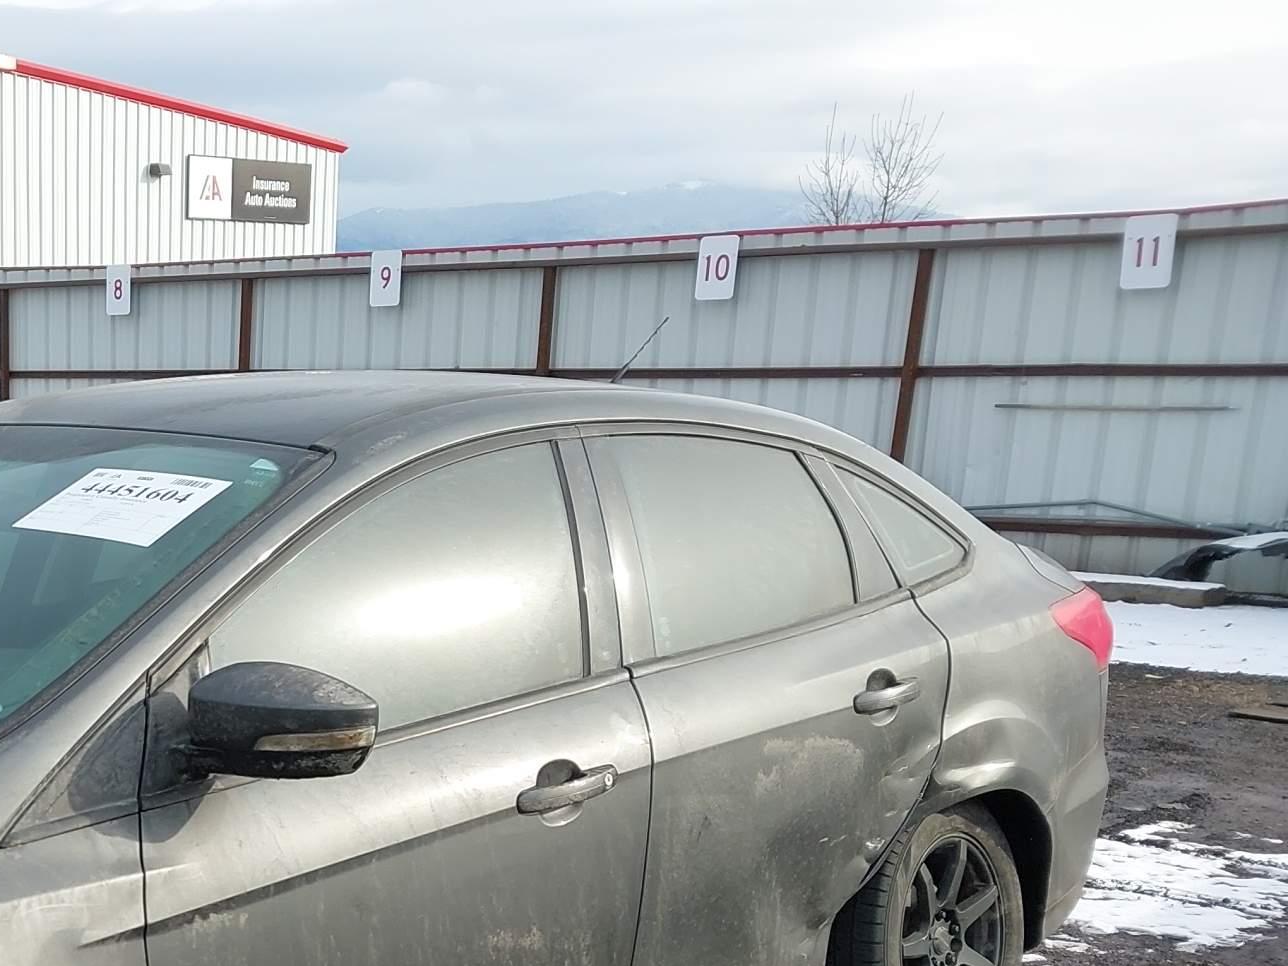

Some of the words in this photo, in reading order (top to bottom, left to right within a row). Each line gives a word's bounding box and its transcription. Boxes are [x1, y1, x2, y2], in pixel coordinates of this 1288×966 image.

[252, 175, 290, 192] Insurance
[244, 191, 263, 206] Auto
[264, 192, 297, 208] Auctions
[1135, 236, 1160, 268] 11
[380, 266, 392, 289] 9
[704, 254, 730, 282] 10
[113, 278, 123, 300] 8
[80, 482, 195, 504] 44451604
